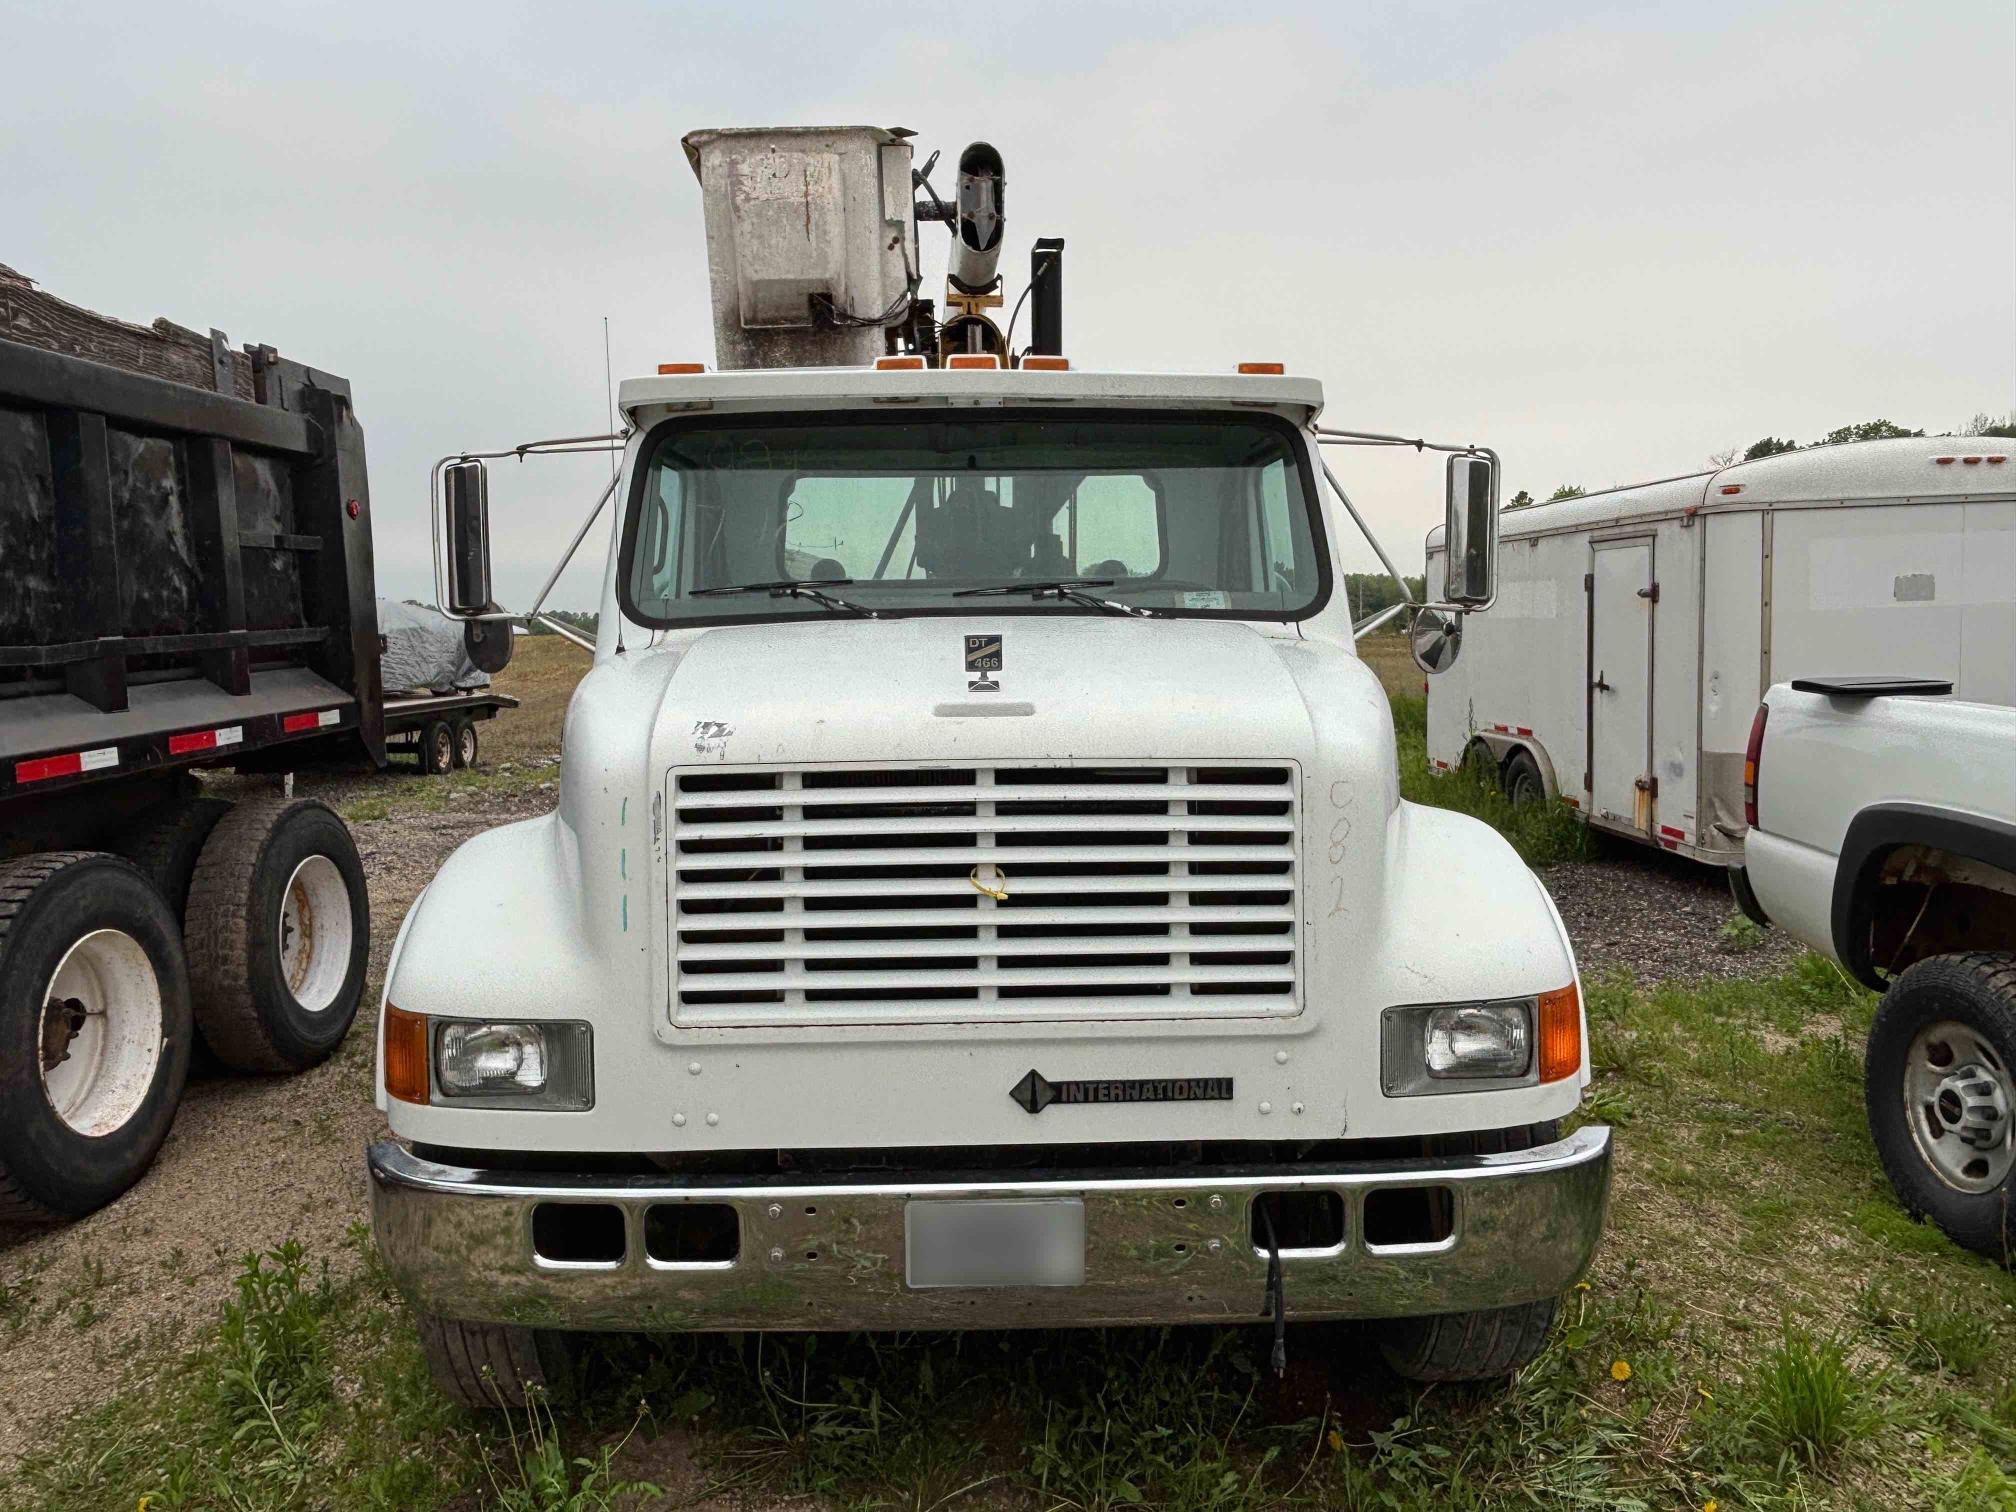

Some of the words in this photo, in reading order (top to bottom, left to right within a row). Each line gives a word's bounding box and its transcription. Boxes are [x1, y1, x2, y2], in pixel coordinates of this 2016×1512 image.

[969, 638, 987, 648] DT
[974, 657, 999, 669] 466
[1061, 1079, 1232, 1102] INTERNATIONAL
